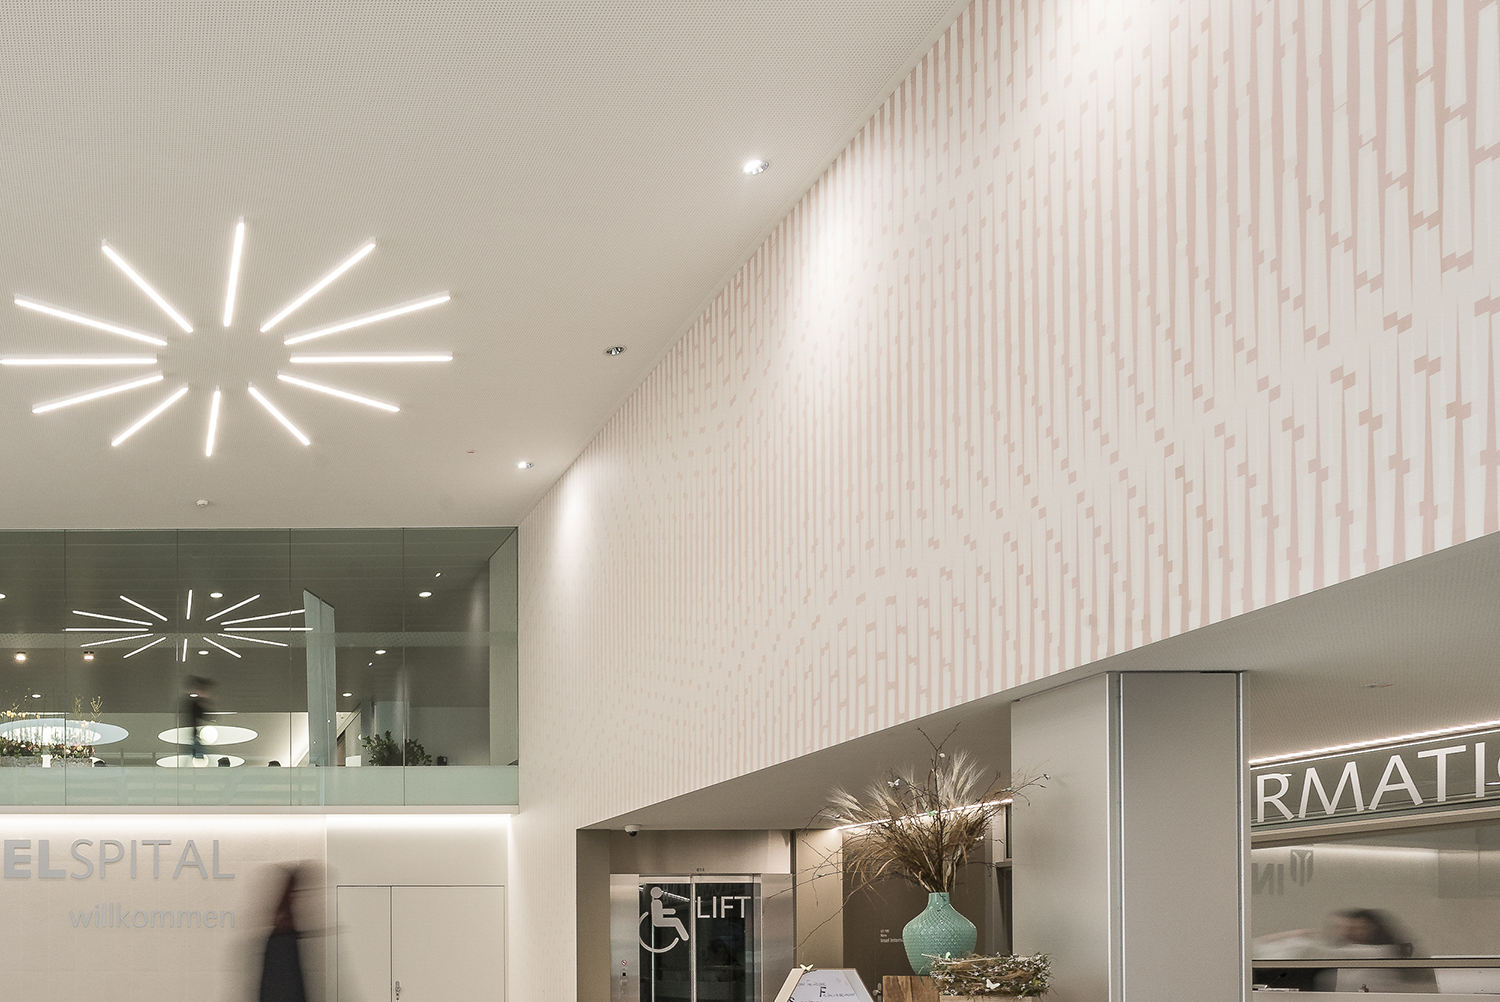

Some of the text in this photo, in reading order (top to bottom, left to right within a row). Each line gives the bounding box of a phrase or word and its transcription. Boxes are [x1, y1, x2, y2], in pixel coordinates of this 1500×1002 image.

[1257, 742, 1500, 823] RMATI
[69, 903, 236, 928] willkommen
[697, 896, 751, 918] LIFT
